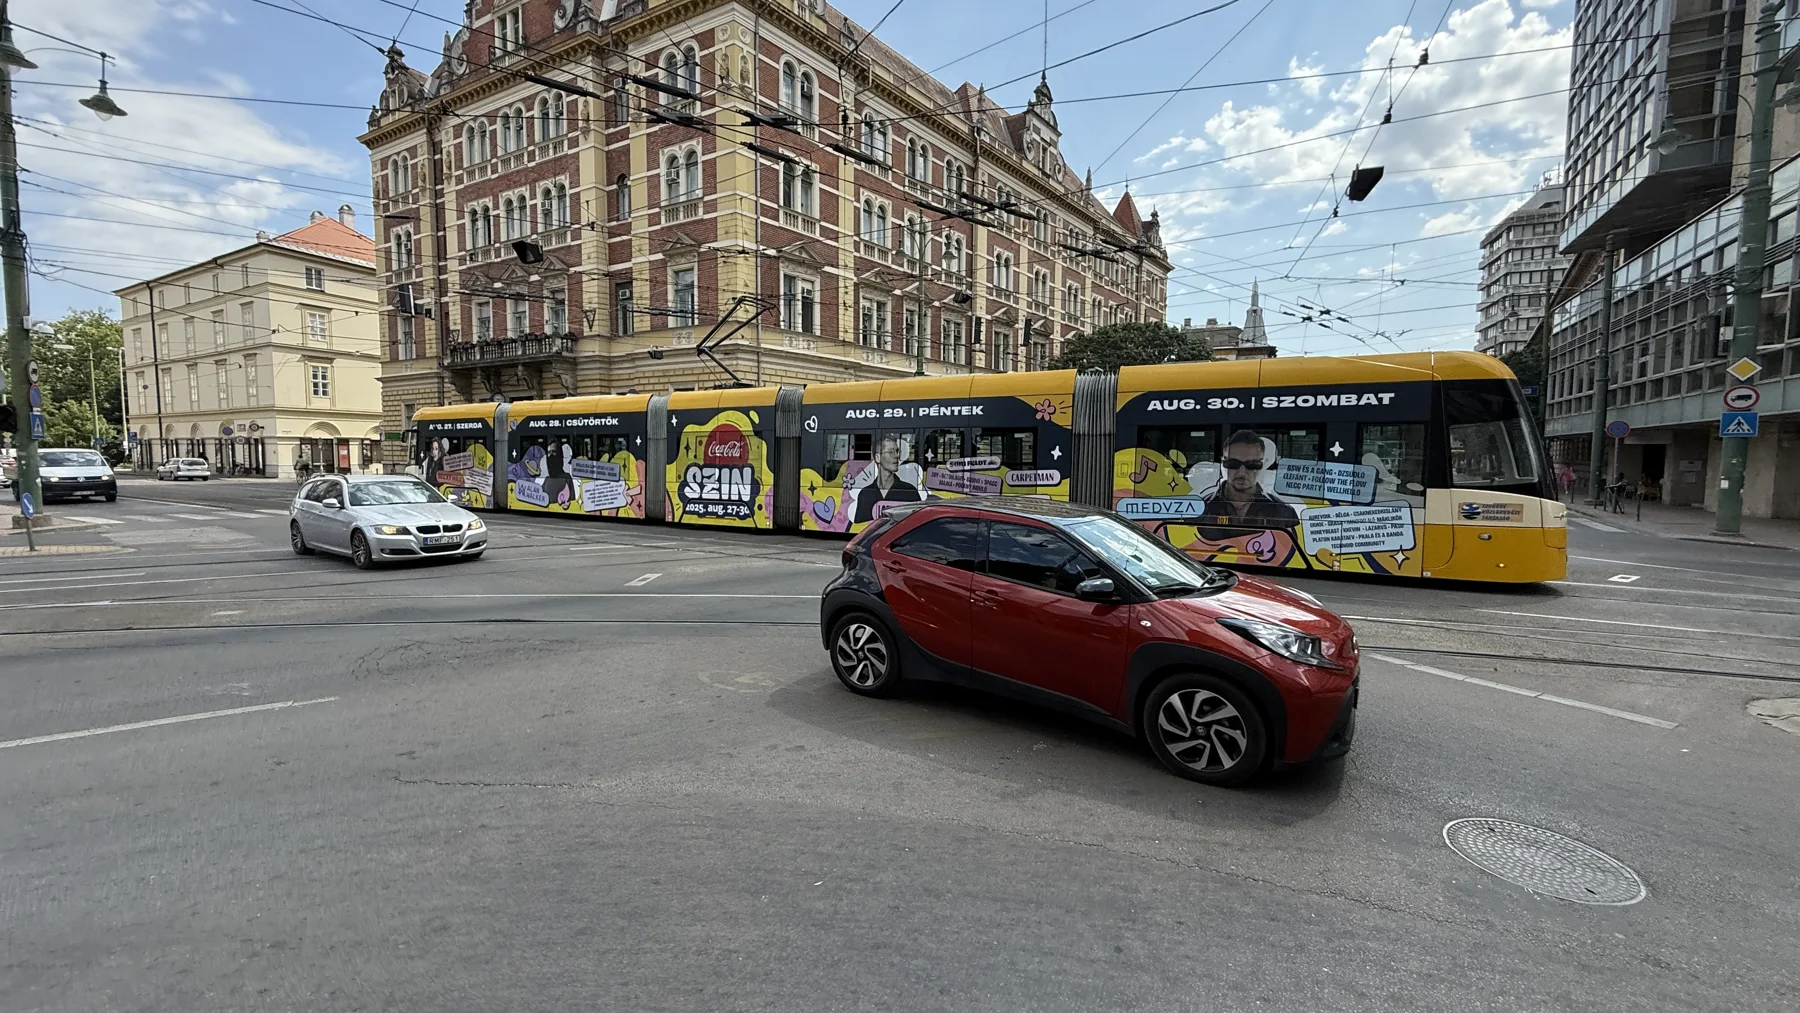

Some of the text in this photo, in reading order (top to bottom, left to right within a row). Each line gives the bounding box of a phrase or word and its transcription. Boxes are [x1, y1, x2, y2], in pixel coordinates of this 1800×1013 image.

[1147, 392, 1395, 410] AUG. 30. SZOMBAT
[846, 404, 984, 418] AUG. 29. PÉNTEK
[529, 420, 547, 428] AUG.
[566, 416, 619, 426] CSÜTÖRTÖK
[1287, 464, 1301, 472] BSW
[1302, 465, 1309, 473] ÉS
[1316, 467, 1334, 476] GANG
[1011, 472, 1054, 482] CARPETMAN
[1283, 472, 1367, 487] ELEFÁNT FOLLOW THE FLOW
[684, 466, 752, 502] SZIN
[1302, 483, 1322, 491] PARTY
[1327, 486, 1360, 495] WELLHELLO
[686, 504, 750, 516] 2025. aug. 27-30
